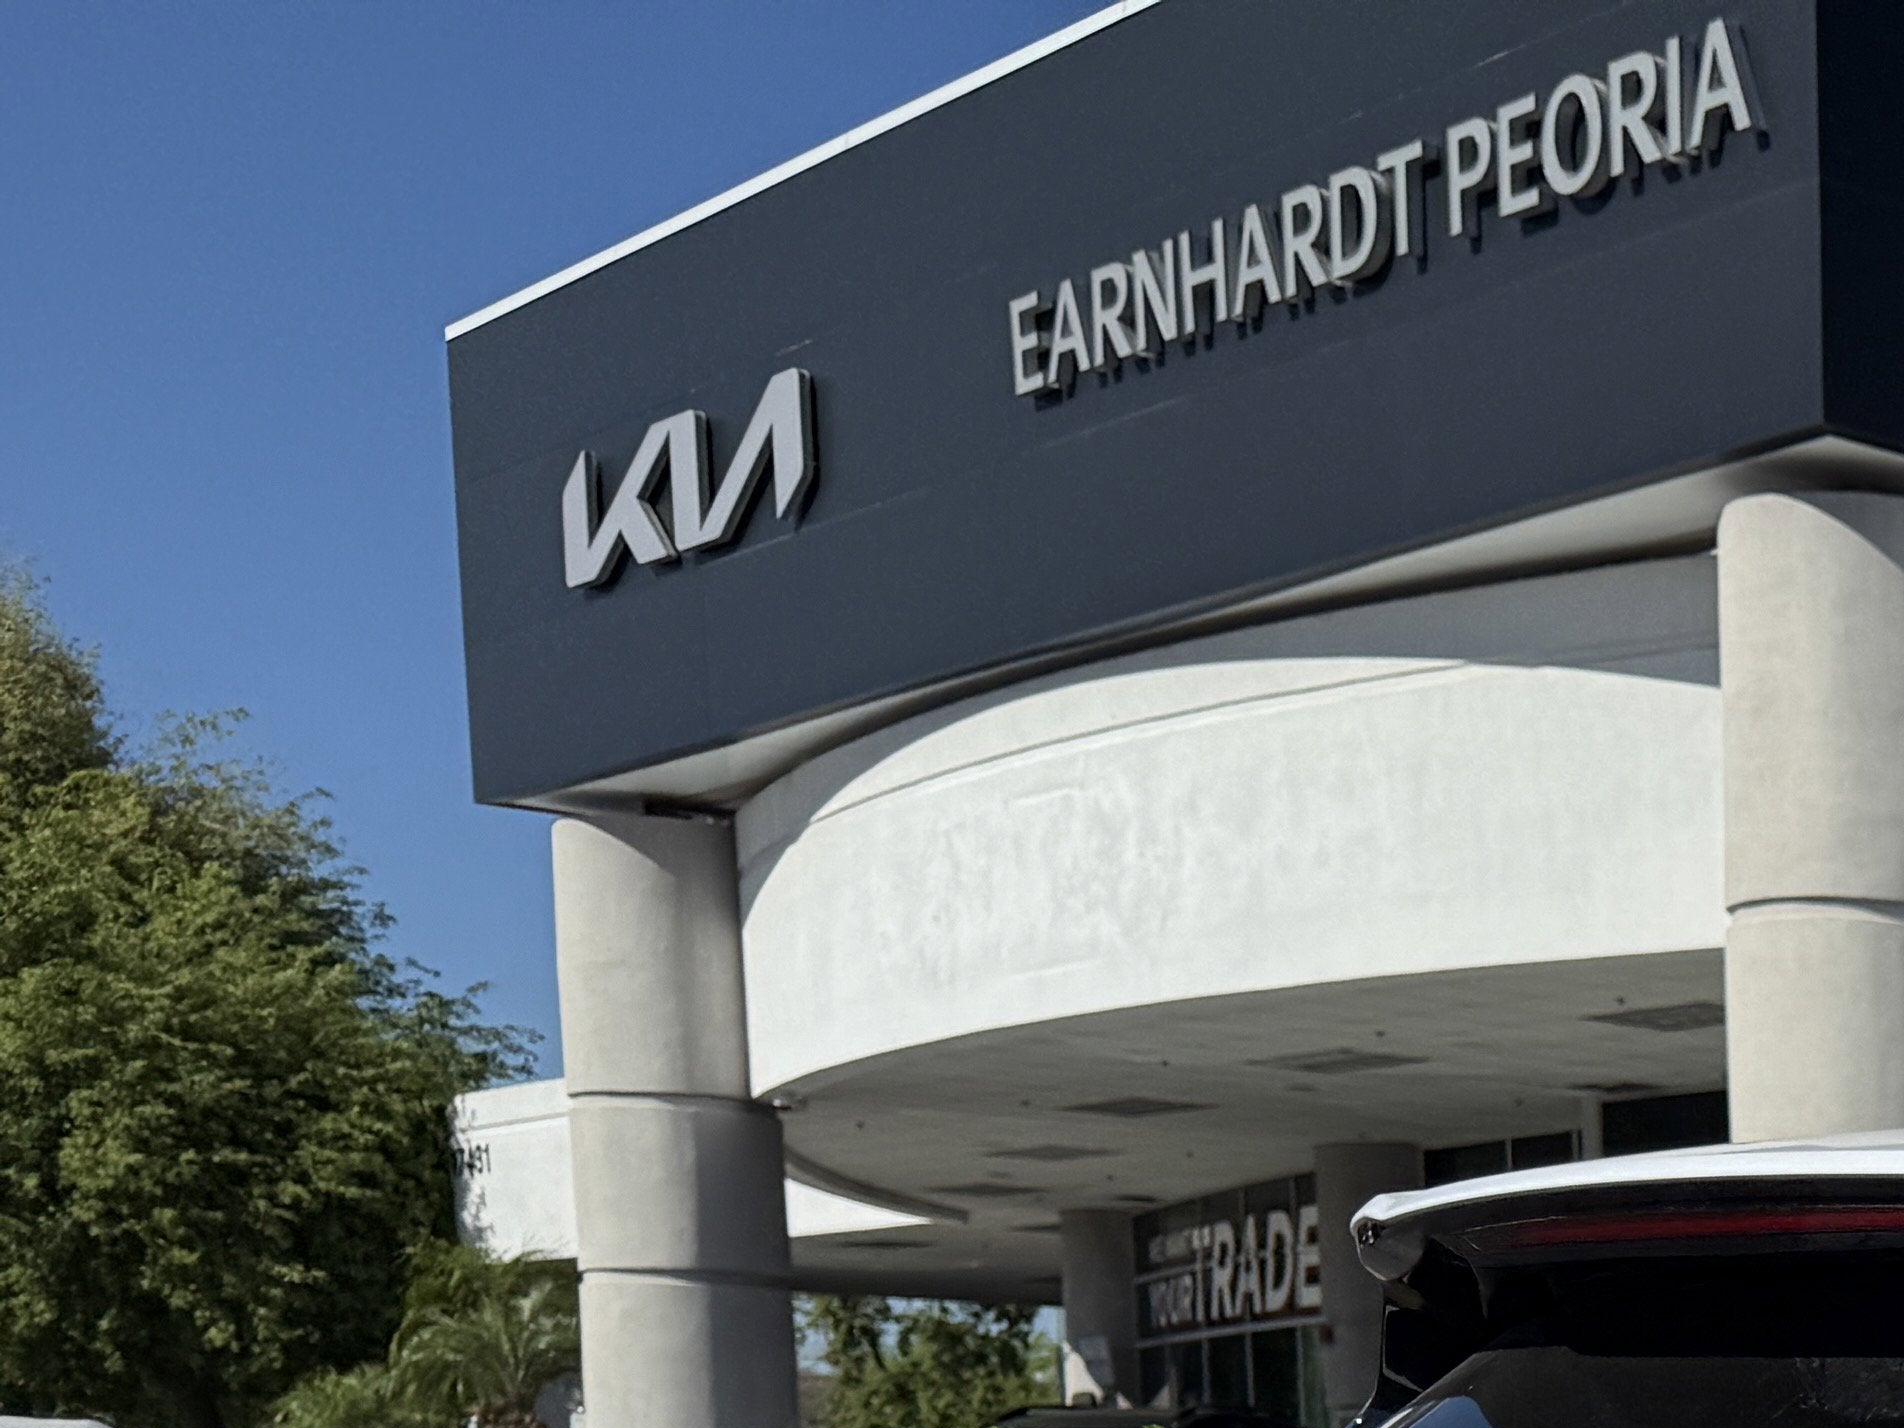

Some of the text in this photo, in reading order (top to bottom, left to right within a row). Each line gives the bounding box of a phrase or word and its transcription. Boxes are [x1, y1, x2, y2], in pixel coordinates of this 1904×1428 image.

[1008, 17, 1756, 397] EARNHARDT PEORIA
[562, 366, 810, 589] KIA
[1191, 1205, 1322, 1324] TRADE
